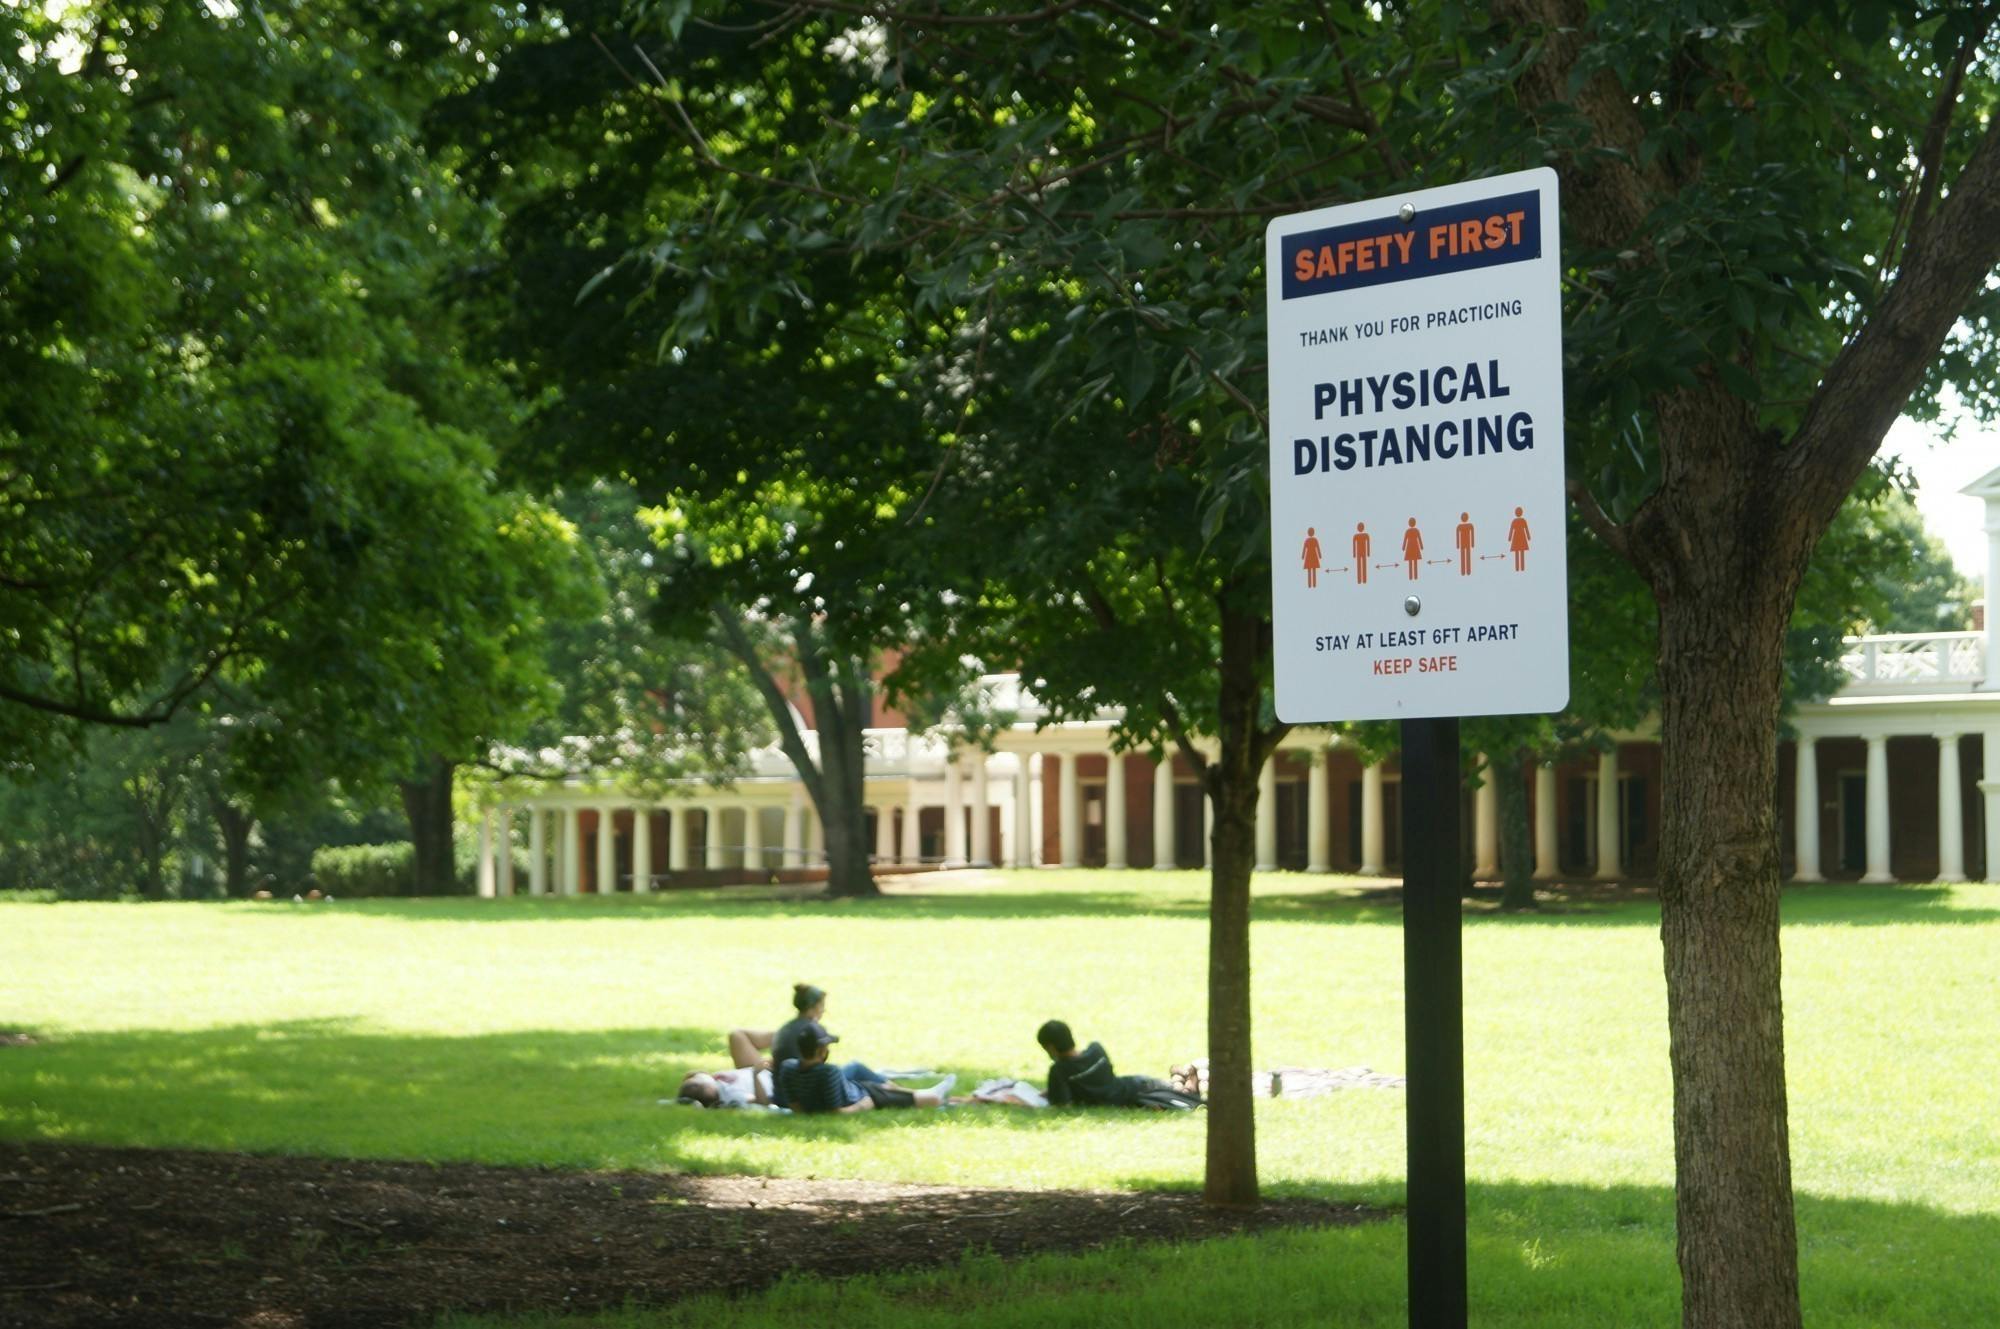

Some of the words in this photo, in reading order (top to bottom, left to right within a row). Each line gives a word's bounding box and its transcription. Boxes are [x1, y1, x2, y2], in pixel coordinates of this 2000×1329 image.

[1295, 231, 1415, 282] SAFETY
[1430, 211, 1524, 259] FIRST
[1300, 326, 1348, 347] THANK
[1355, 321, 1383, 338] YOU
[1391, 315, 1419, 333] FOR
[1427, 300, 1522, 328] PRACTICING
[1315, 360, 1509, 420] PHYSICAL
[1294, 411, 1534, 475] DISTANCING
[1315, 635, 1350, 651] STAY
[1357, 633, 1373, 649] AT
[1380, 630, 1426, 647] LEAST
[1432, 627, 1460, 644] 6FT
[1467, 624, 1518, 642] APART
[1374, 658, 1412, 675] KEEP
[1419, 656, 1457, 673] SAFE
